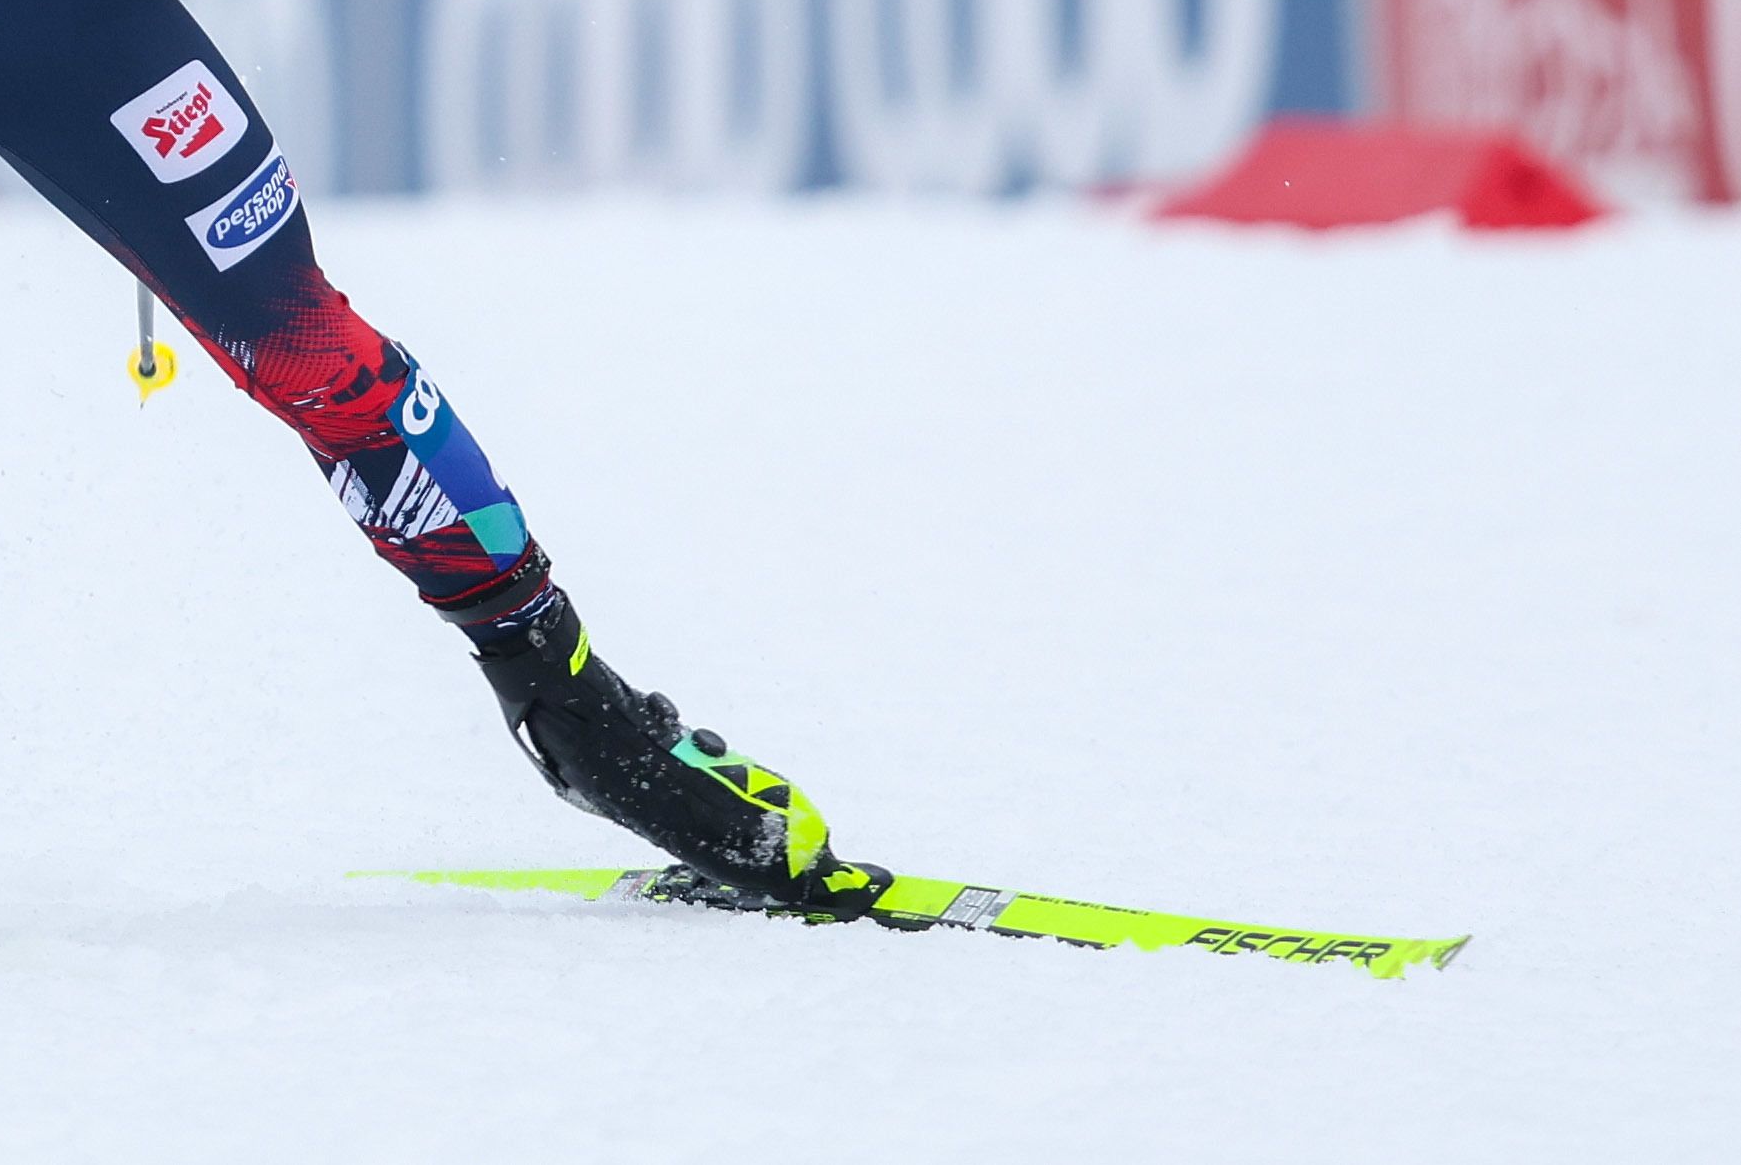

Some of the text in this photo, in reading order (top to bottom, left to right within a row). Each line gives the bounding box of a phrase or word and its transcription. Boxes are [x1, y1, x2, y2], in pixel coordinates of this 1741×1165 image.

[141, 81, 212, 160] Stiegl
[214, 157, 288, 241] personal
[243, 187, 286, 235] shop
[1185, 927, 1393, 968] FISCHER
